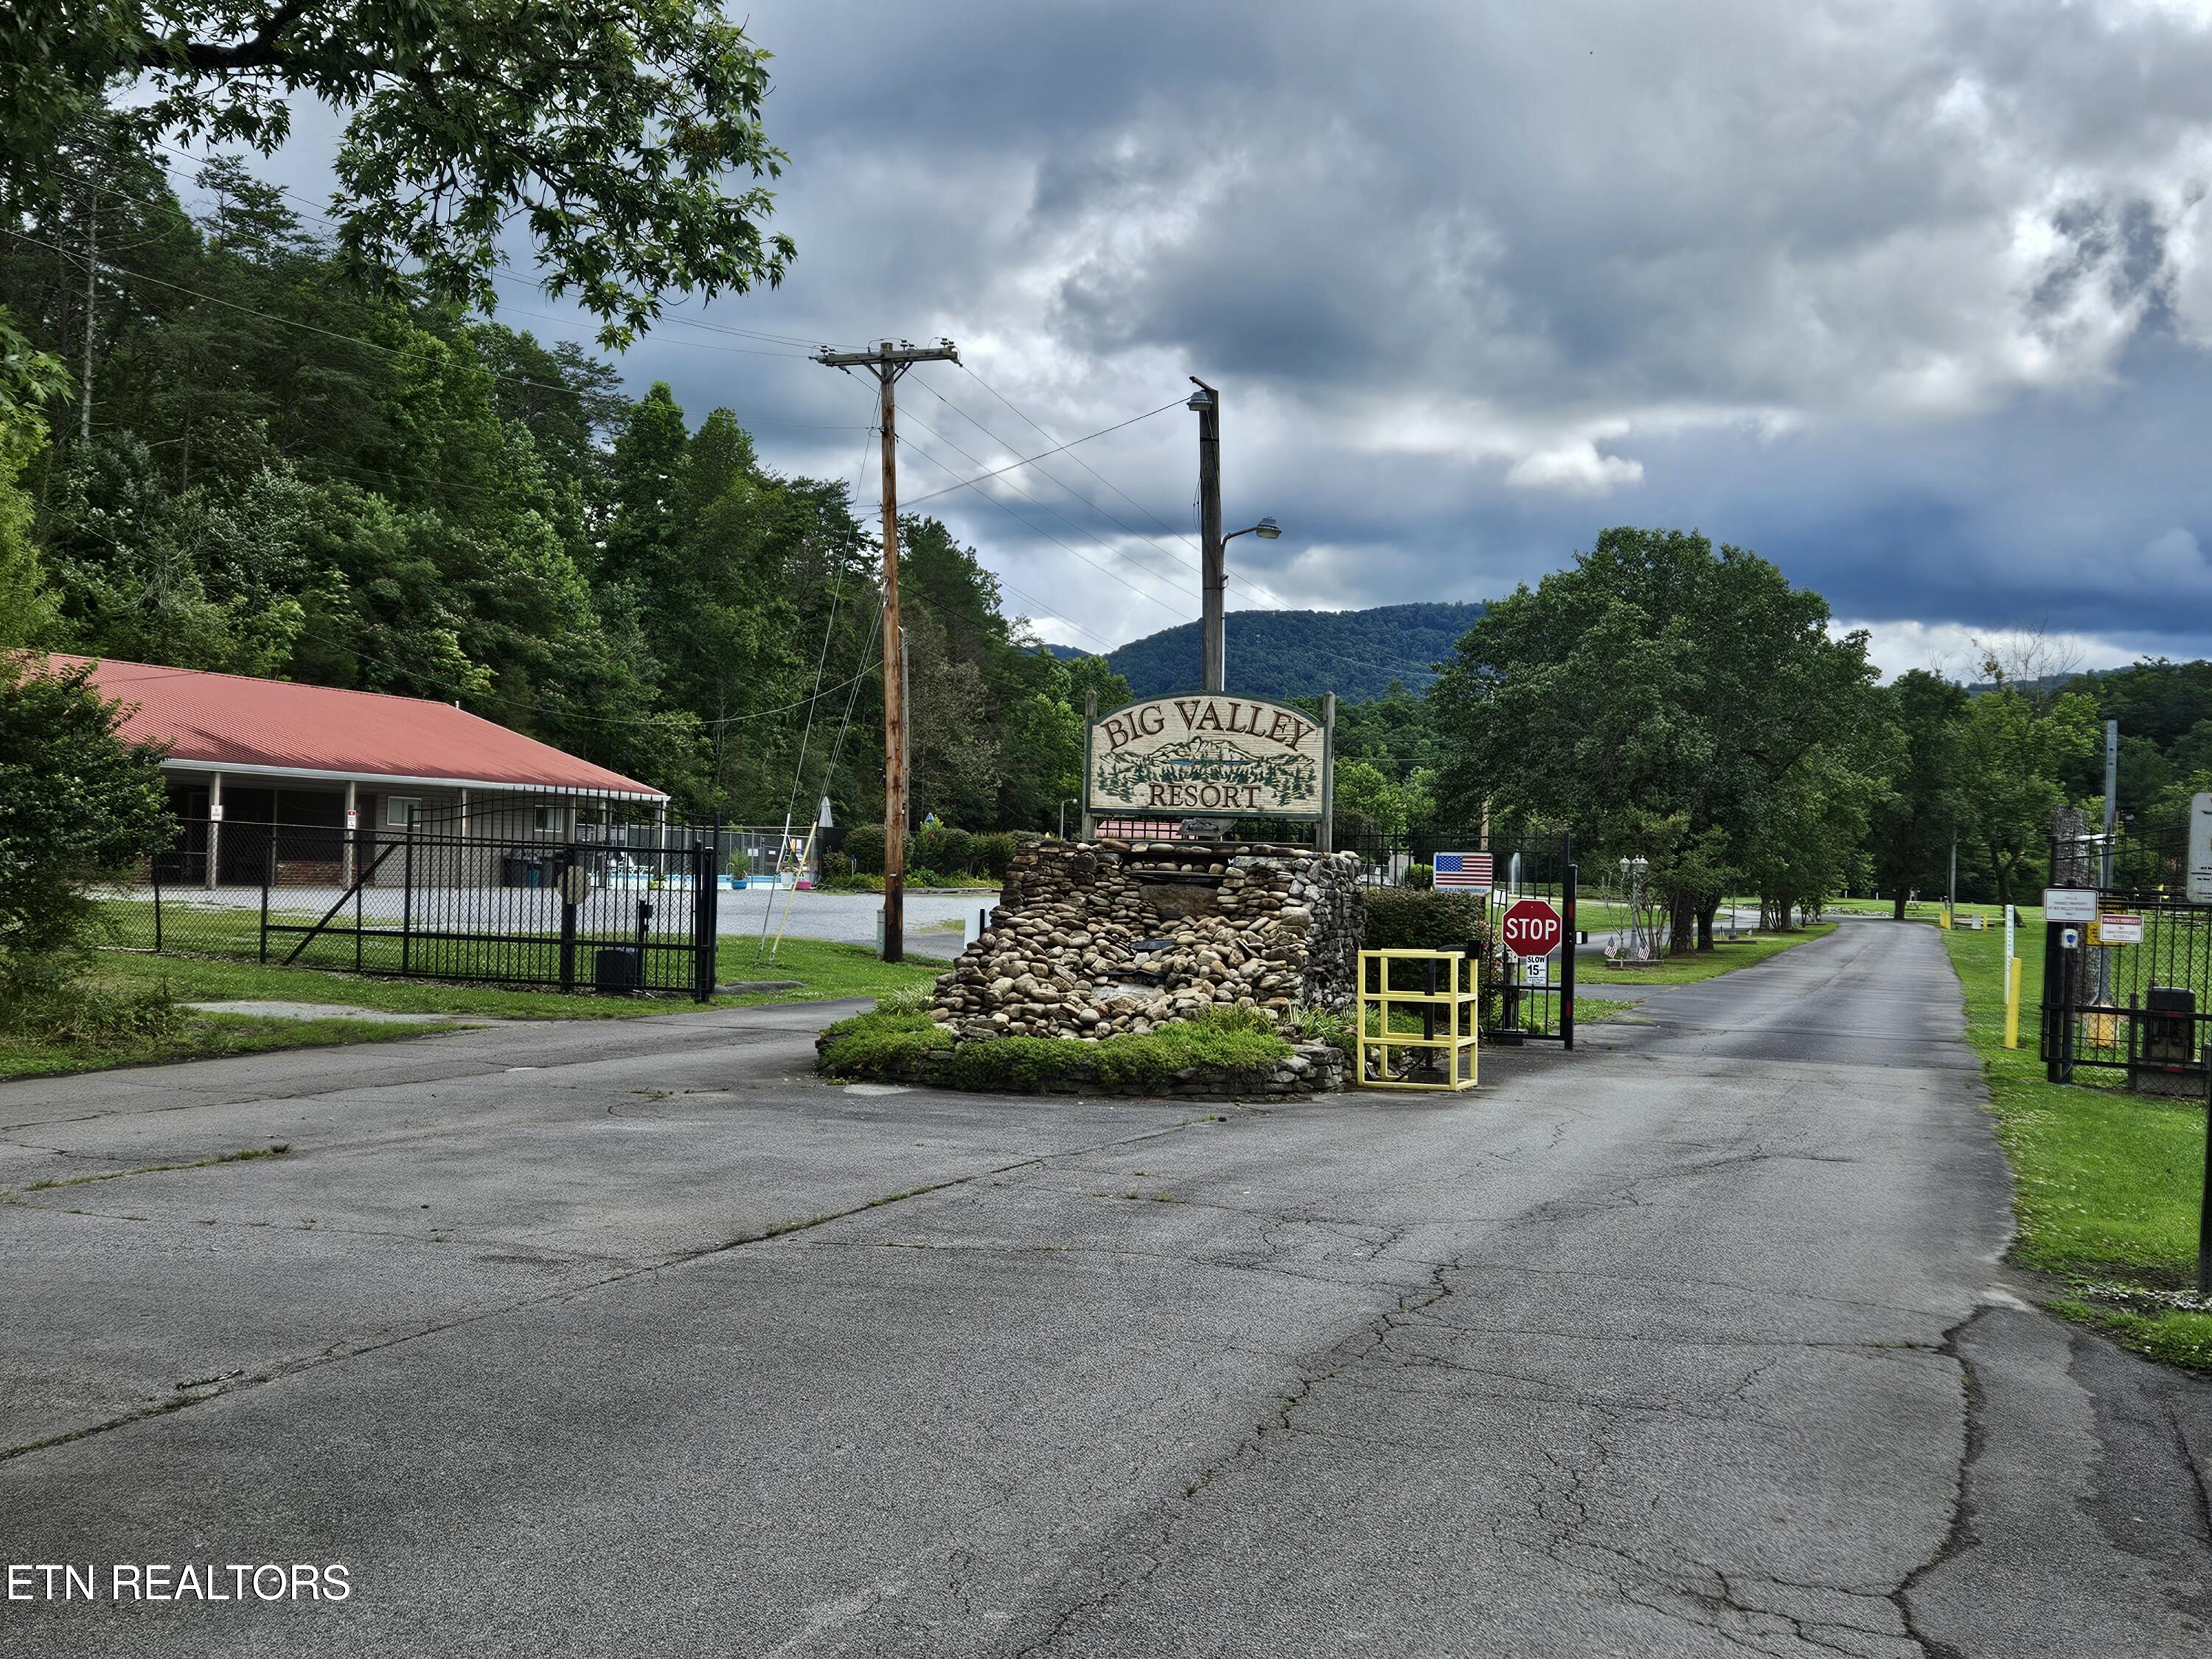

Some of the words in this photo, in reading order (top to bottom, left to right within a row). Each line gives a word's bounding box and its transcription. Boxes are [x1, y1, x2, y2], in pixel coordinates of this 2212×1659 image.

[1100, 704, 1165, 751] BIG
[1175, 700, 1316, 752] VALLEY
[1149, 784, 1262, 808] RESORT
[1506, 917, 1557, 940] STOP
[1527, 964, 1540, 975] 15
